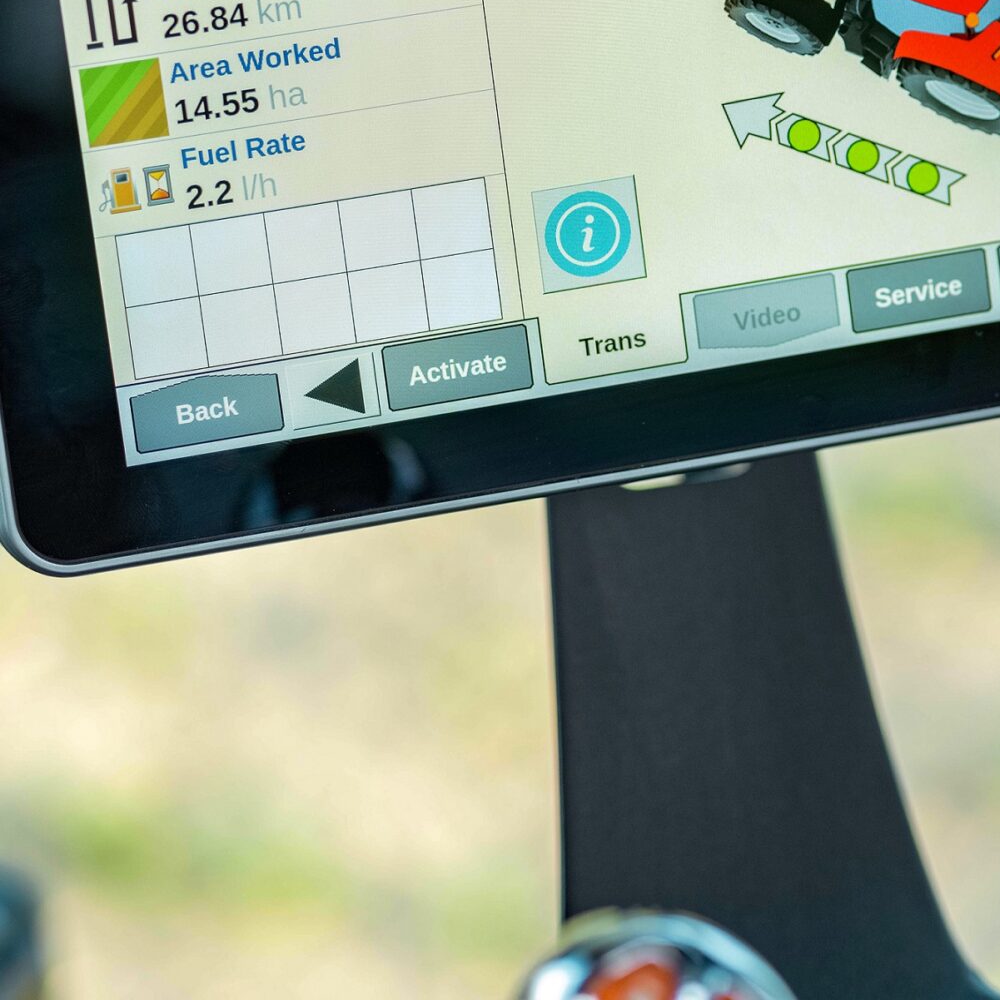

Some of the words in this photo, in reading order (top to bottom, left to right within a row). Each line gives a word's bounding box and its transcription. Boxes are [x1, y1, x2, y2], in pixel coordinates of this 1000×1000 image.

[162, 3, 249, 39] 26.84
[170, 55, 232, 84] Area
[238, 38, 341, 73] Worked
[174, 88, 260, 124] 14.55
[269, 83, 307, 109] ha
[180, 140, 238, 169] Fuel
[245, 132, 306, 158] Rate
[186, 180, 234, 209] 2.2
[874, 275, 963, 309] Service
[733, 304, 801, 333] Video
[579, 329, 647, 358] Trans
[408, 352, 508, 386] Activate
[175, 396, 239, 426] Back
